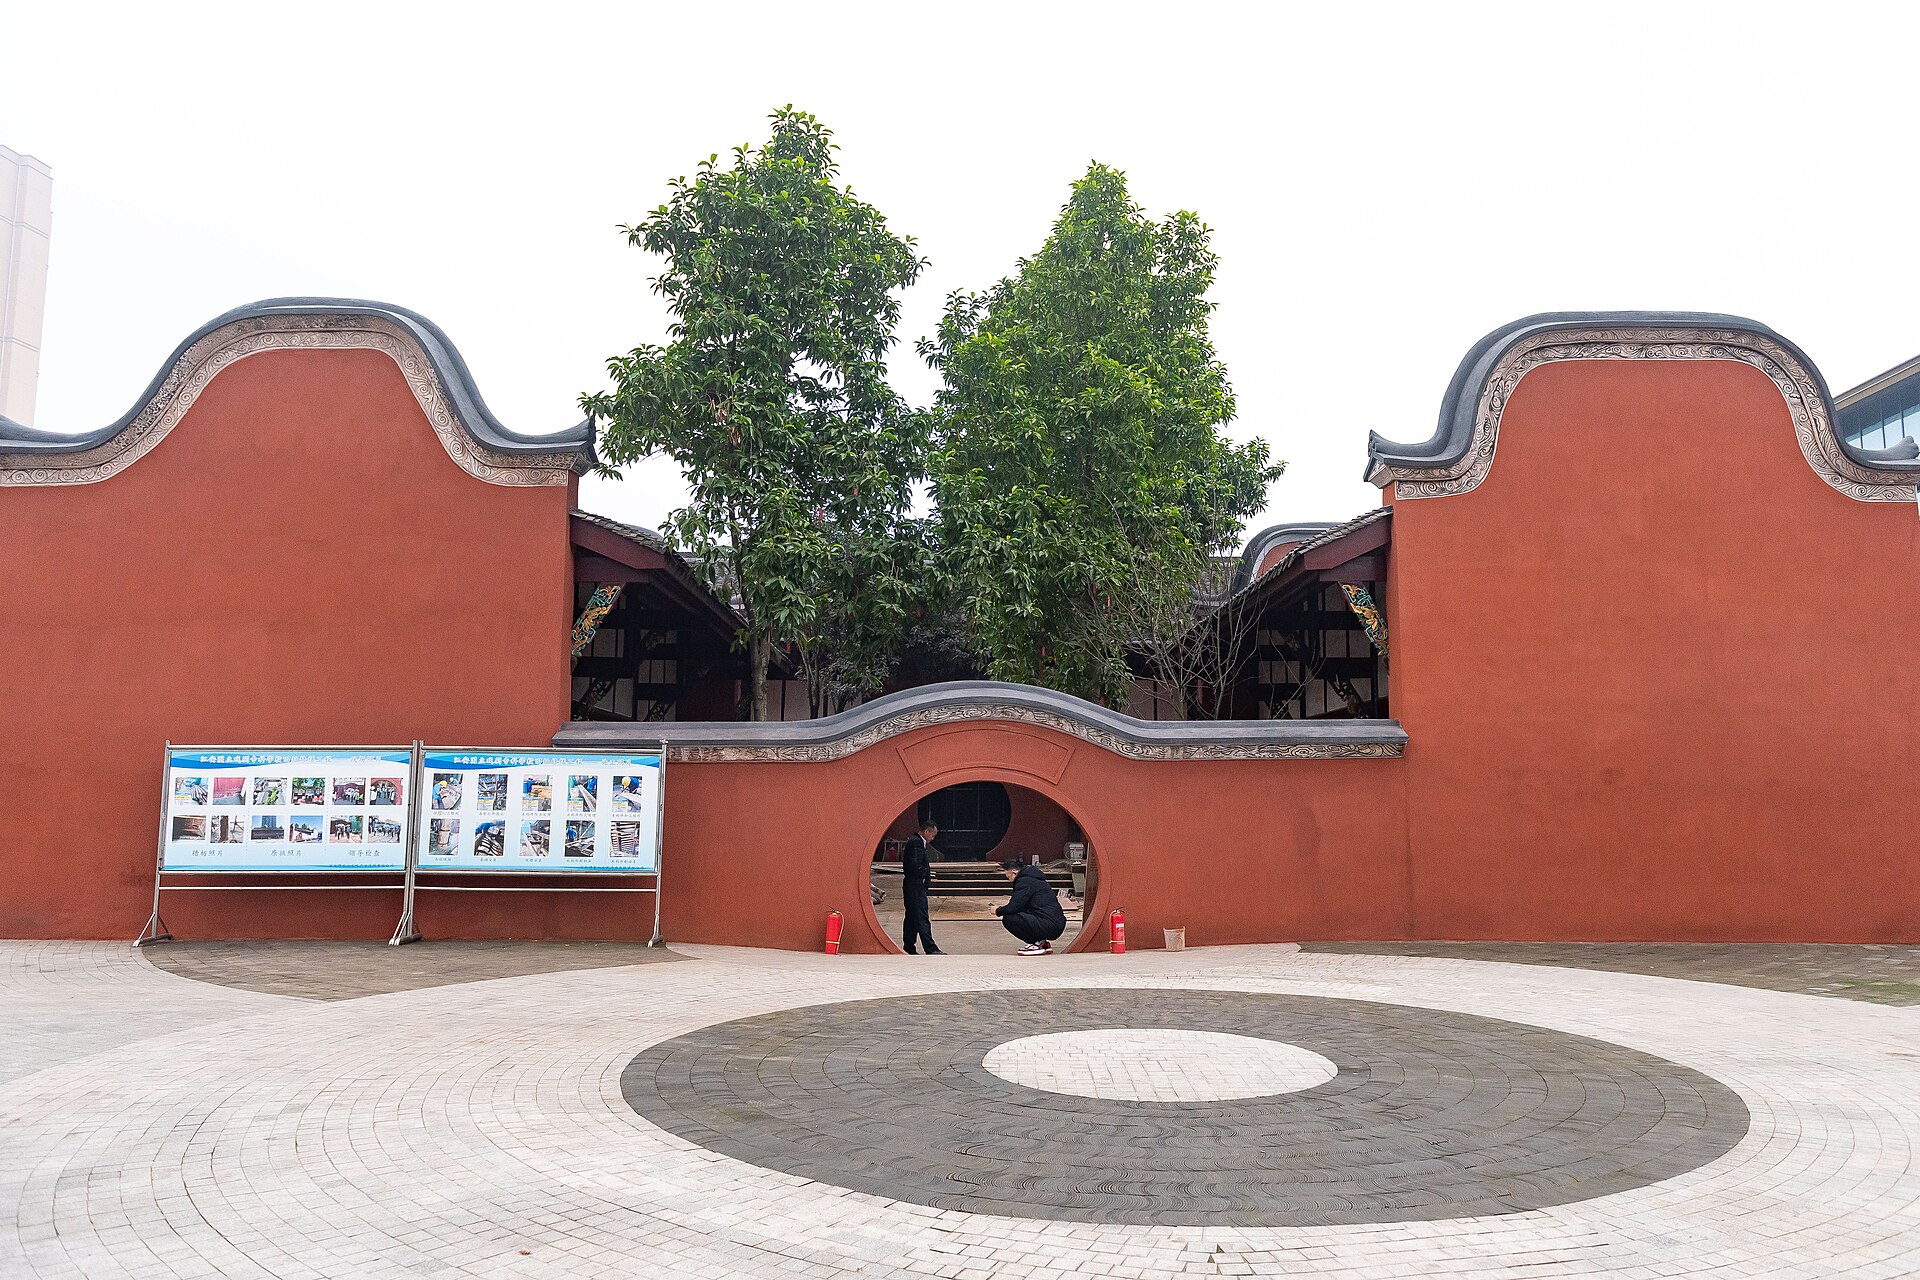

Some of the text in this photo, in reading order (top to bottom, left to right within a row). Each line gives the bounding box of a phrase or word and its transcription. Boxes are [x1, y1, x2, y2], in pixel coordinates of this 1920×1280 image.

[270, 849, 301, 857] 原状照片
[348, 849, 380, 857] 领导检查
